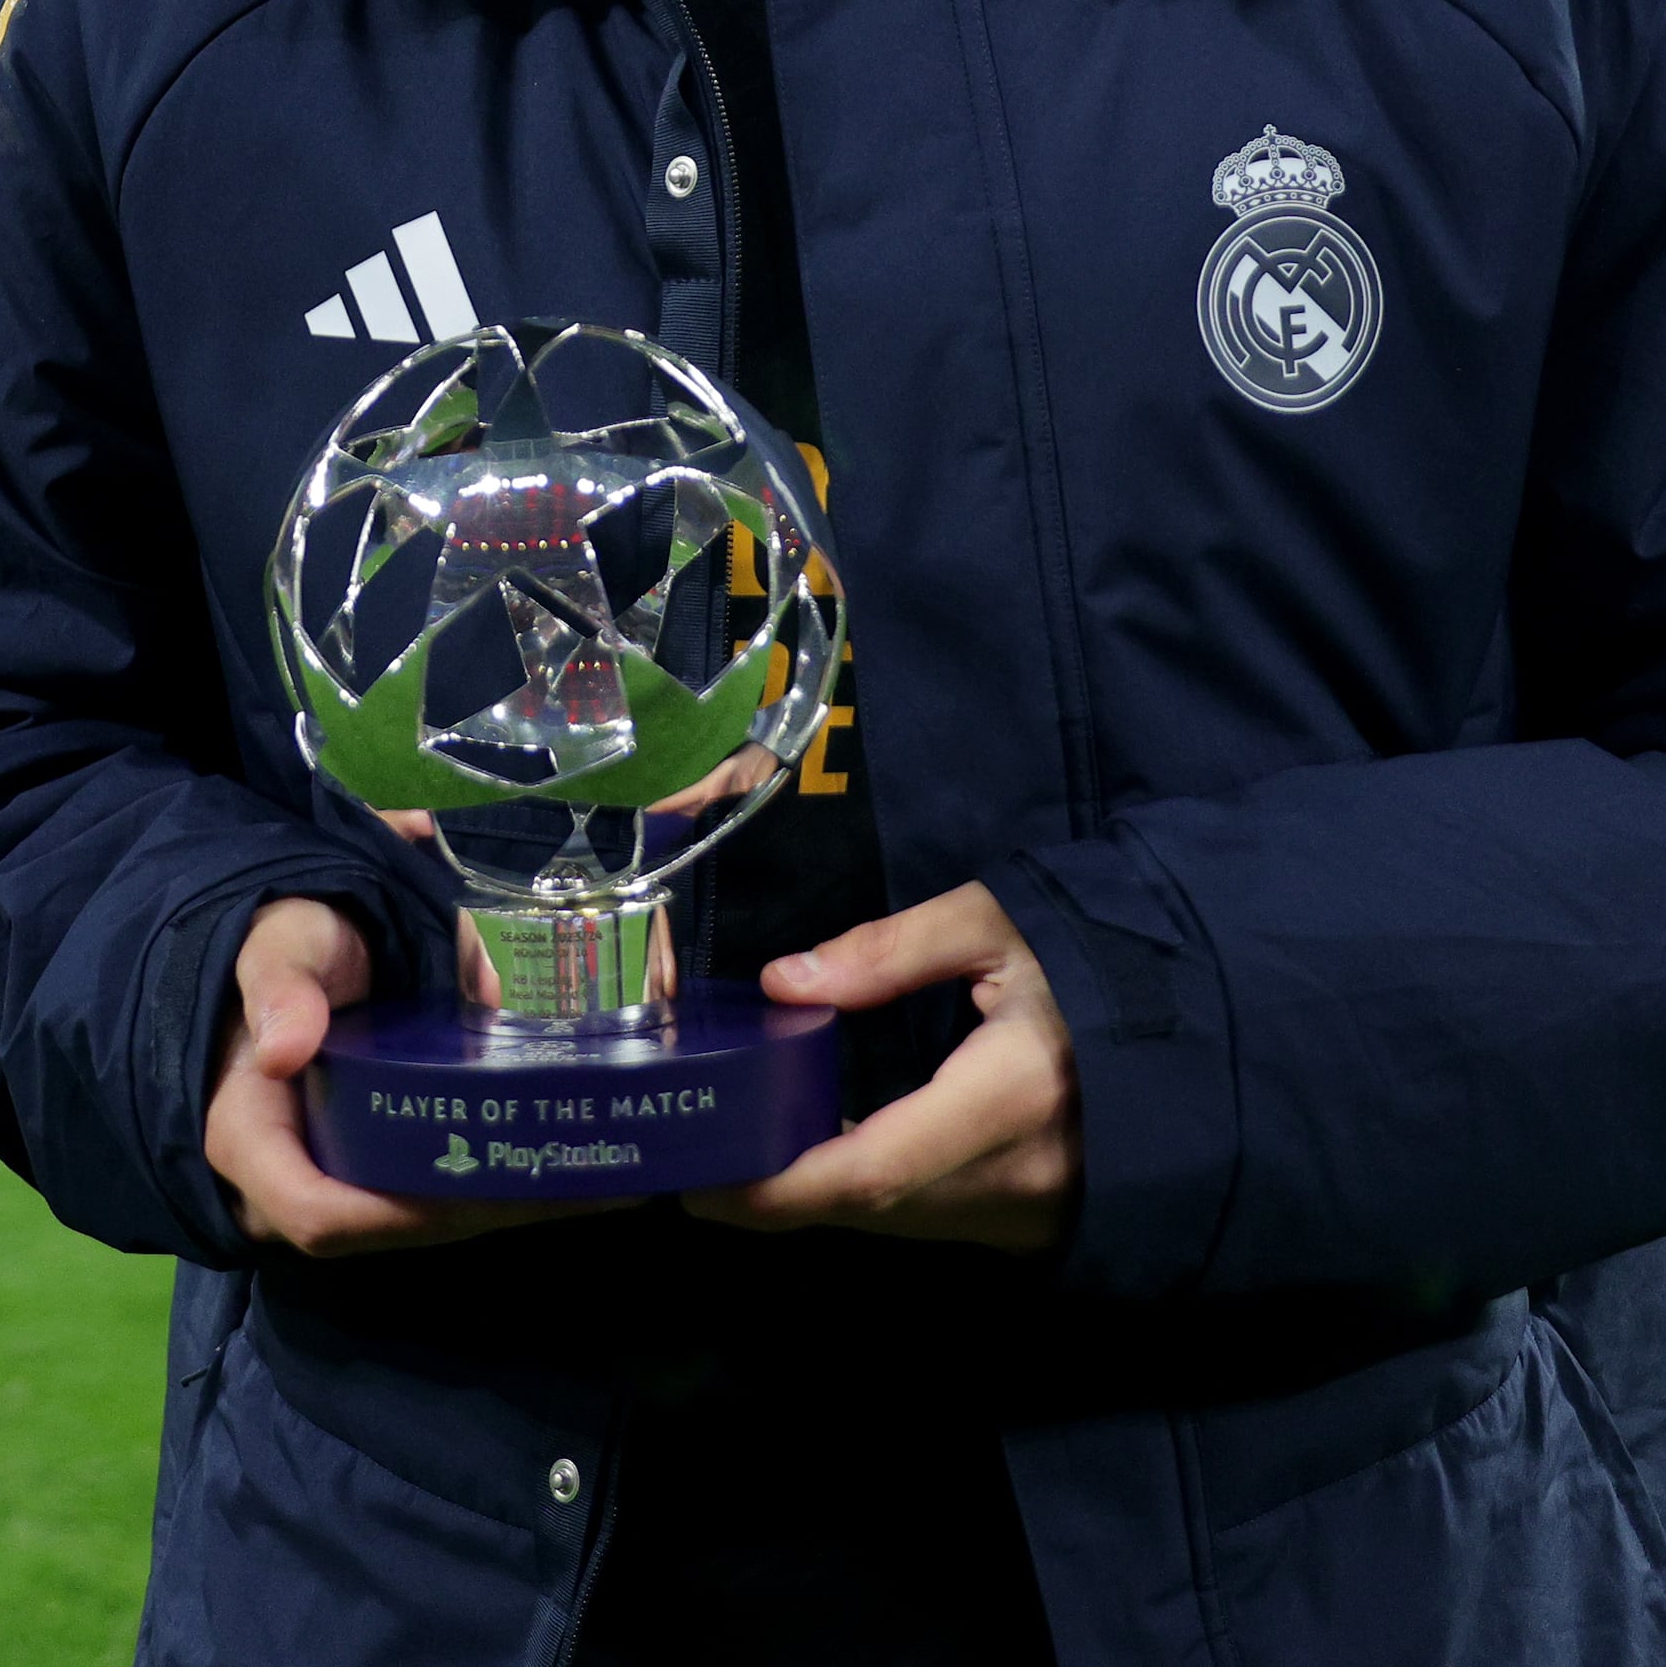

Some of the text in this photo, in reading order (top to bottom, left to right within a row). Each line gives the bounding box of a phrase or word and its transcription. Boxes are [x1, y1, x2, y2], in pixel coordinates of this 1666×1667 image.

[500, 931, 547, 943] SEASON
[371, 1086, 717, 1122] PLAYER OF THE MATCH
[487, 1138, 642, 1177] PlayStation
